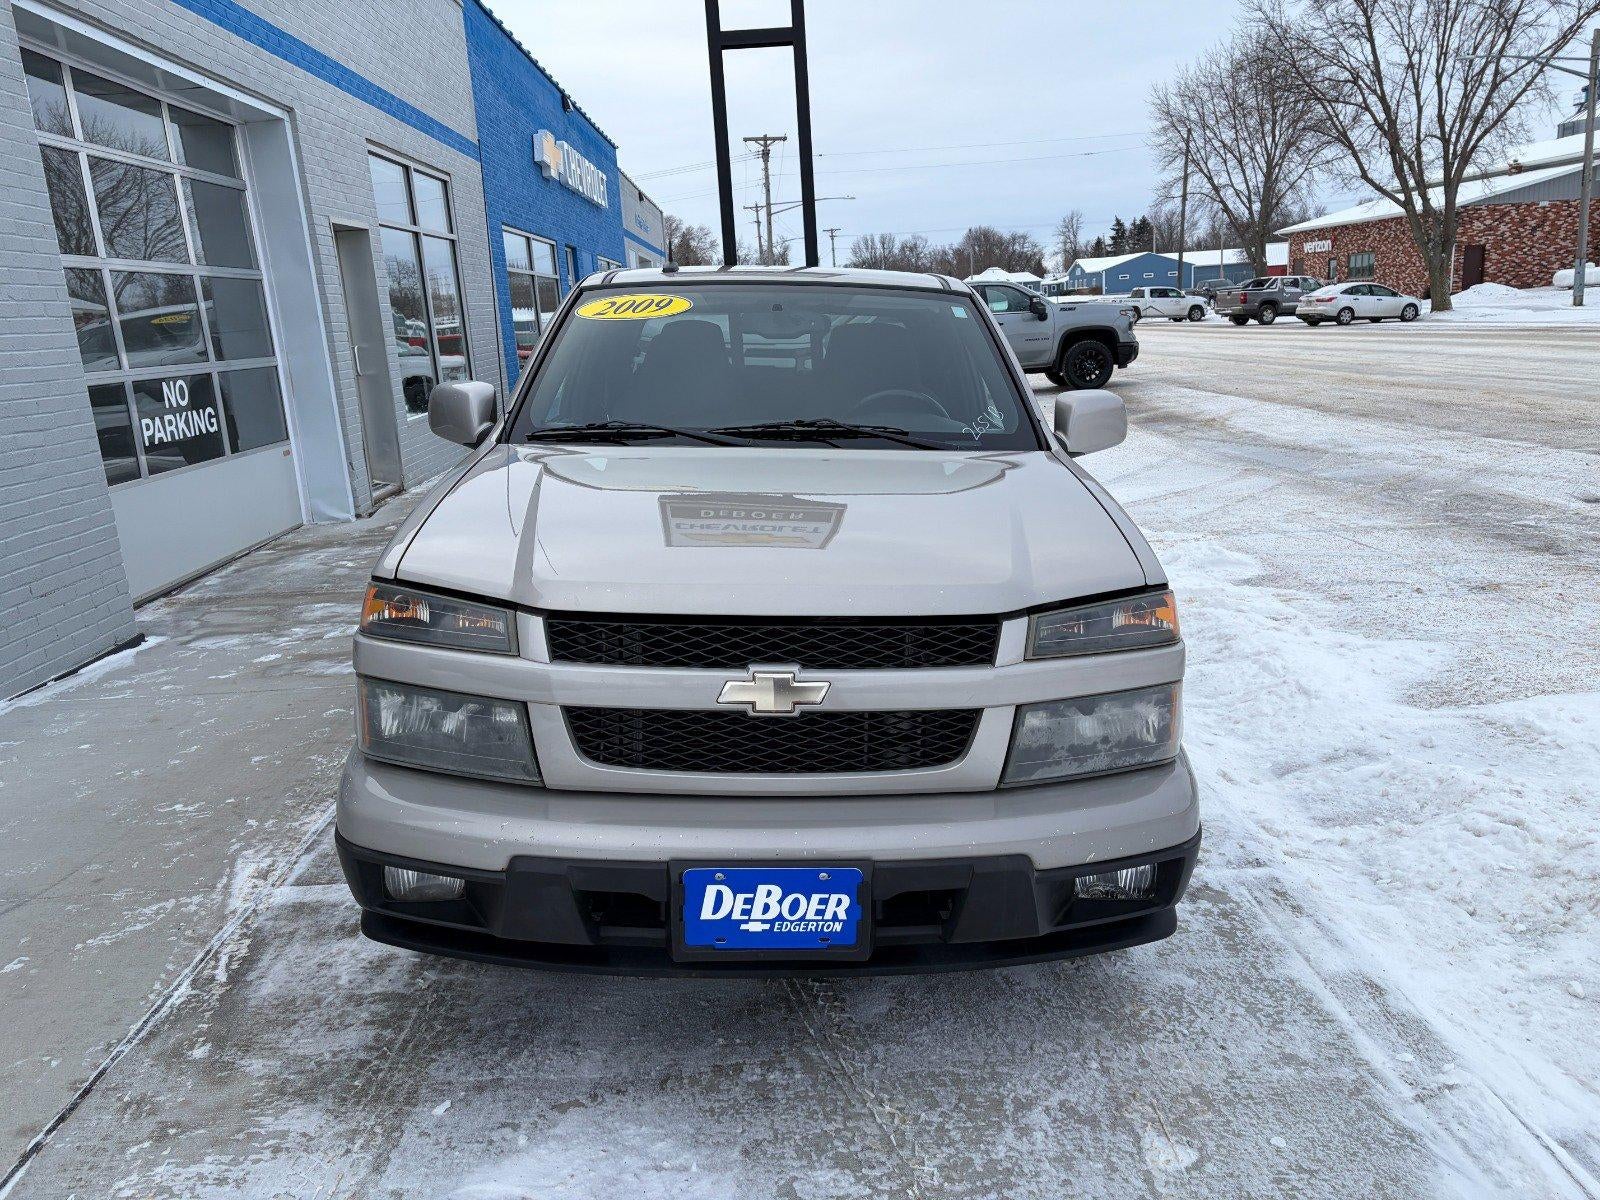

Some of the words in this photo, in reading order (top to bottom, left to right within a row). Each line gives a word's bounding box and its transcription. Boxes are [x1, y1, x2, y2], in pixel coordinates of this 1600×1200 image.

[559, 141, 608, 209] CHEVROLET
[1303, 237, 1332, 254] verizon
[592, 298, 674, 316] 2009
[161, 379, 189, 409] NO
[141, 406, 218, 446] PARKING
[773, 921, 843, 932] EDGERTON
